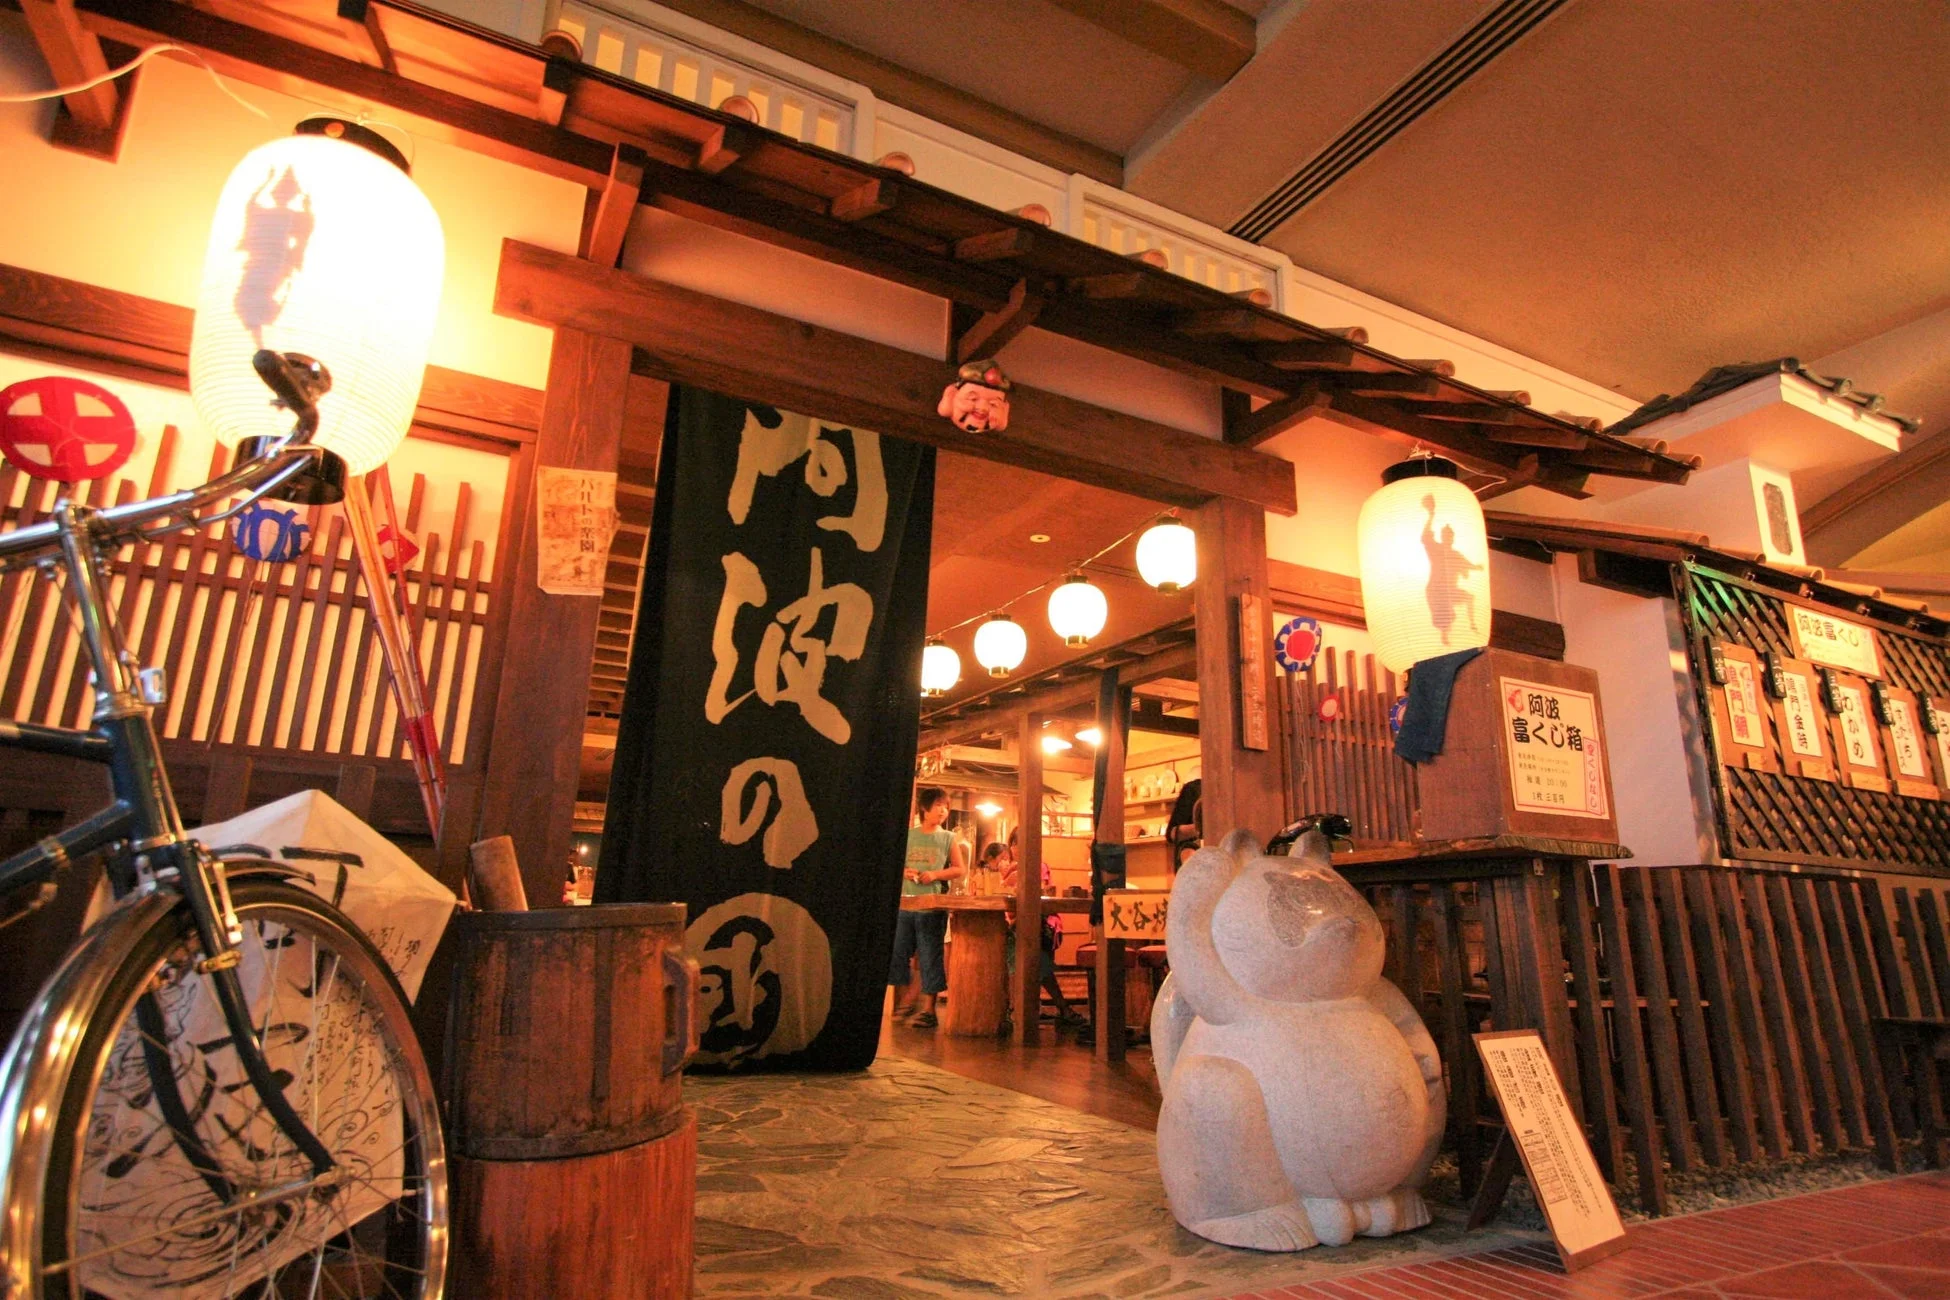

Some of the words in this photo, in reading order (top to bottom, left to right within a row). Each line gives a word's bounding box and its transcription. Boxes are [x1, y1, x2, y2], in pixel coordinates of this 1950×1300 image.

[1528, 693, 1560, 720] 阿波
[1512, 716, 1583, 752] 富くじ箱
[1841, 693, 1864, 759] わかめ
